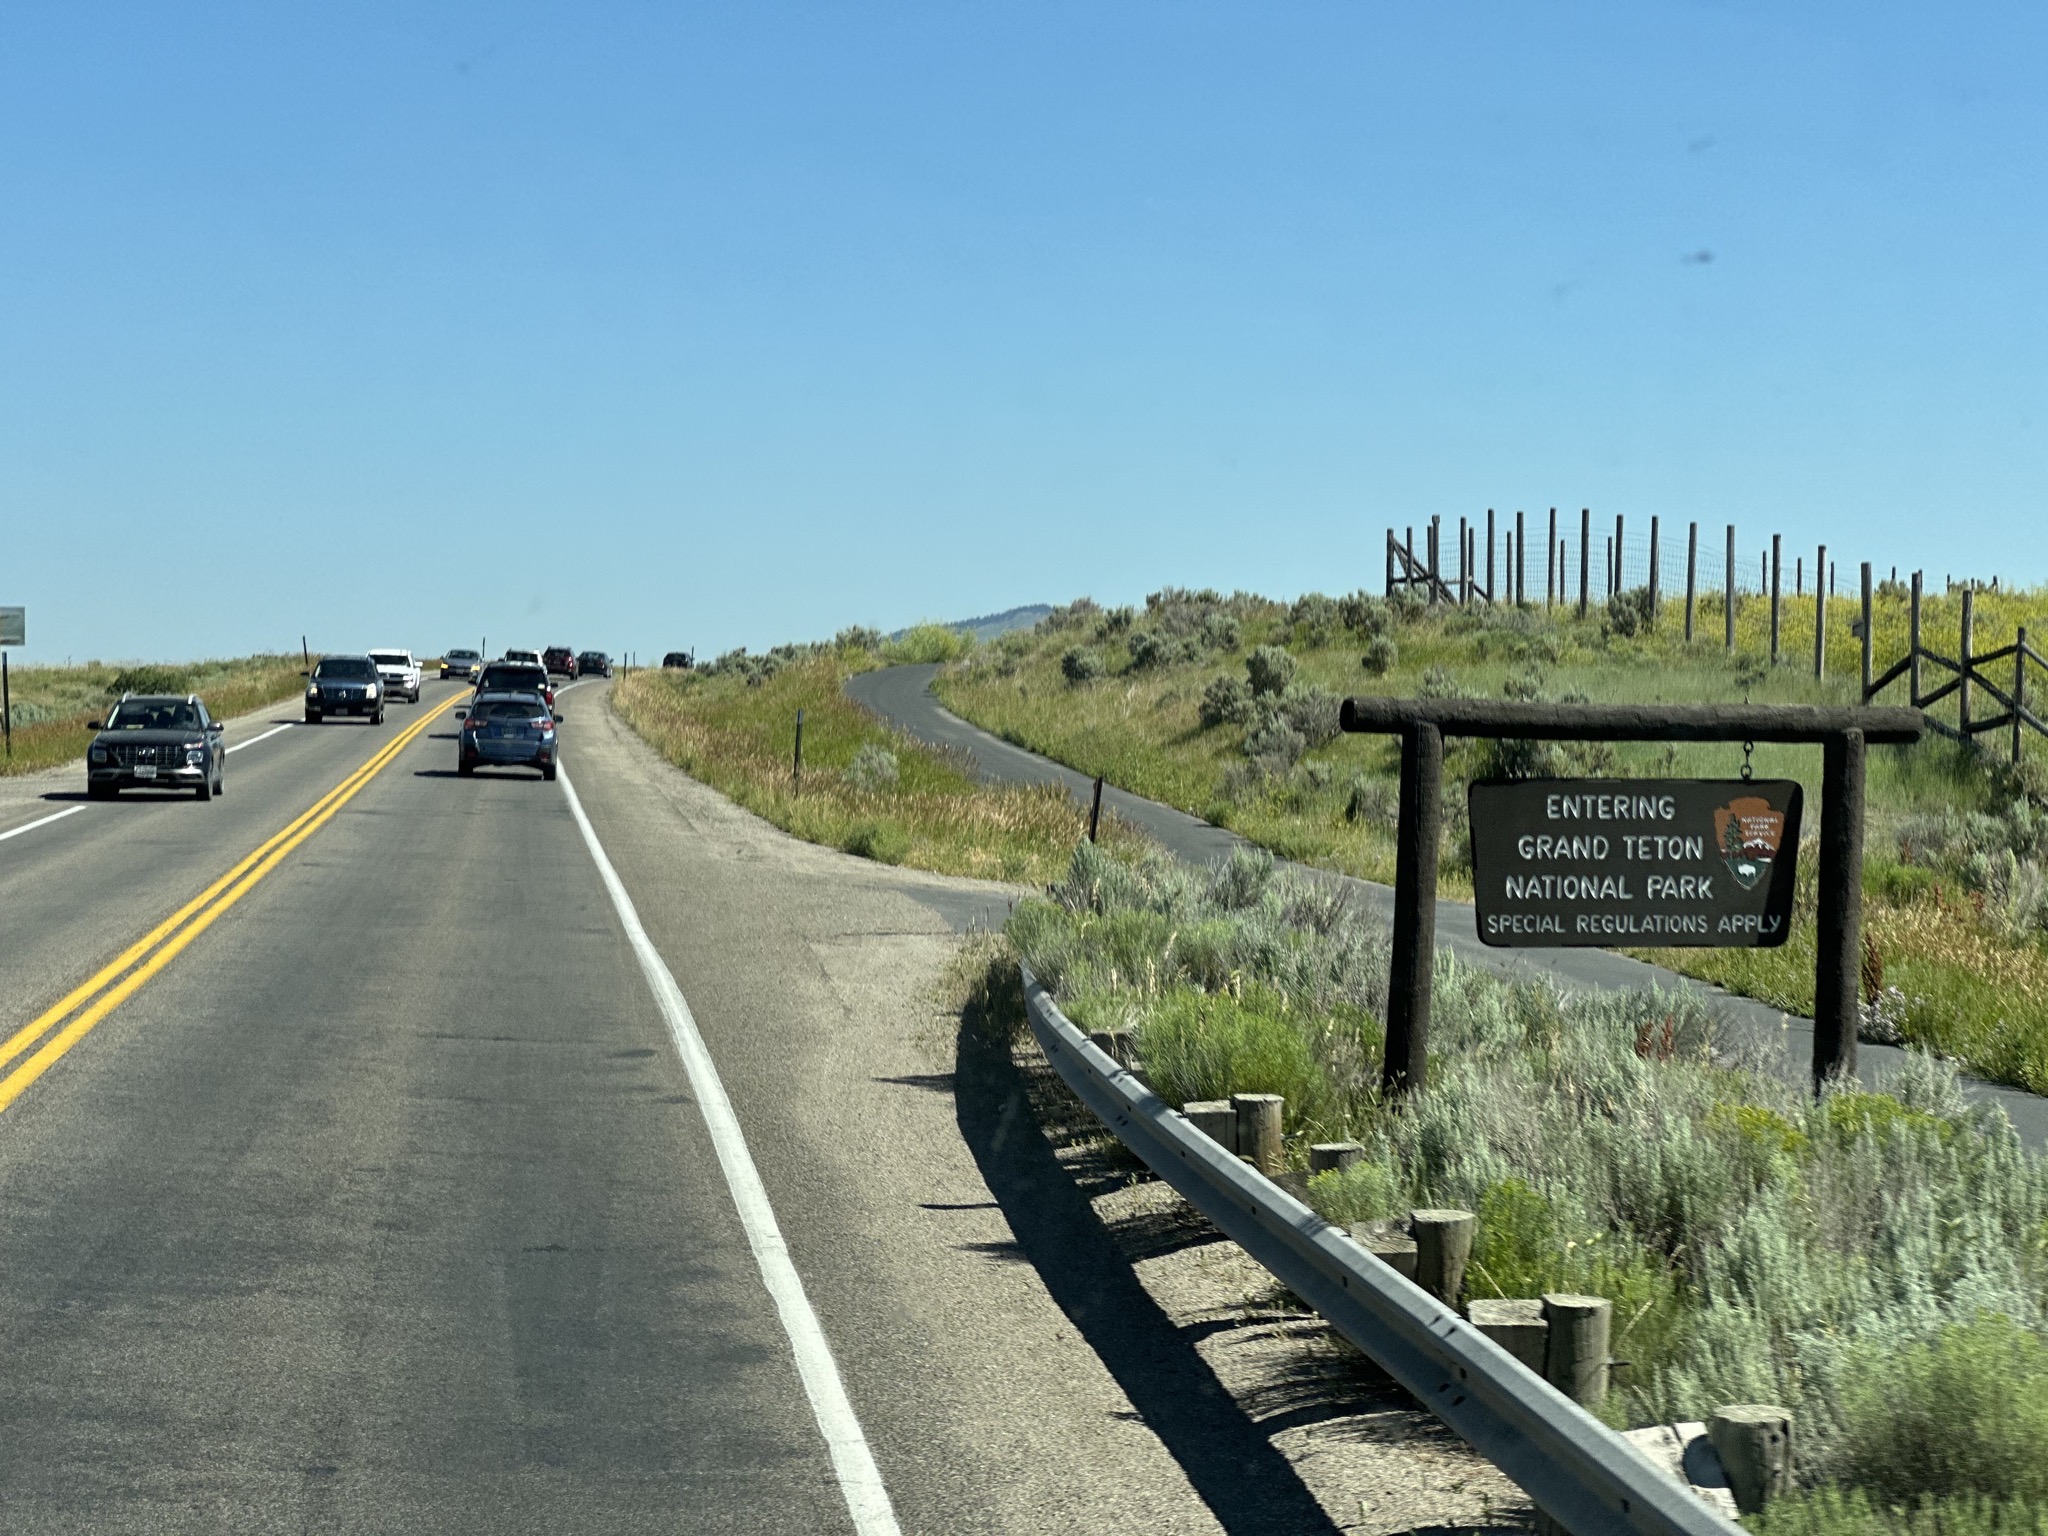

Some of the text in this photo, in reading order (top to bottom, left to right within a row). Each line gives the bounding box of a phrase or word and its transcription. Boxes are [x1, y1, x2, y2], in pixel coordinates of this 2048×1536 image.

[1546, 794, 1676, 820] ENTERING
[1741, 816, 1778, 824] NATIONAL
[1517, 835, 1704, 861] GRAND TETON
[1505, 875, 1714, 900] NATIONAL PARK
[1487, 914, 1781, 934] SPECIAL REGULATIONS APPLY
